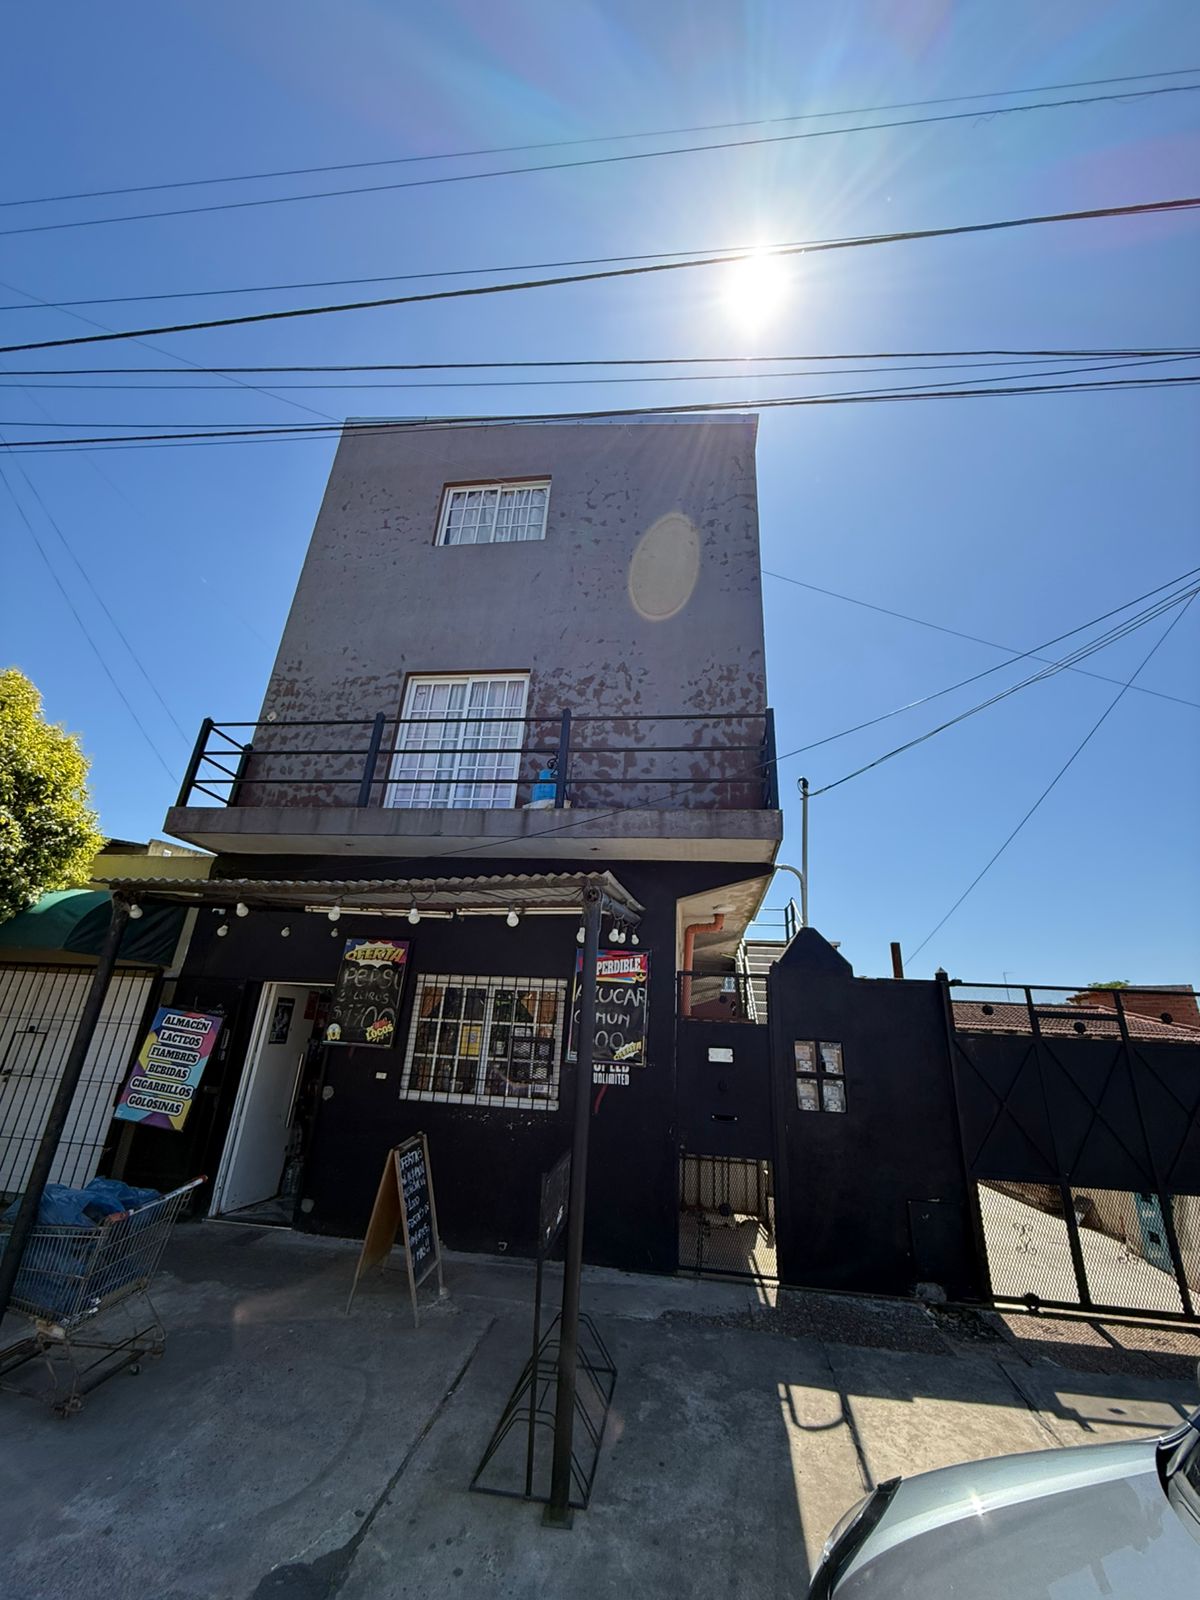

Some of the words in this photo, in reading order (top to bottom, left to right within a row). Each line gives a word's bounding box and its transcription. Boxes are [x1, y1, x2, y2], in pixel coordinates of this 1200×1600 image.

[345, 947, 405, 962] OFERTA
[597, 958, 641, 975] PERDIBLE
[161, 1032, 201, 1047] LACTEOS
[366, 1024, 394, 1040] LOCOS
[151, 1047, 199, 1064] FIAMBRES
[148, 1063, 189, 1079] BEBIDAS
[132, 1078, 192, 1098] CIGARRILLOS
[128, 1096, 181, 1114] GOLOSINAS
